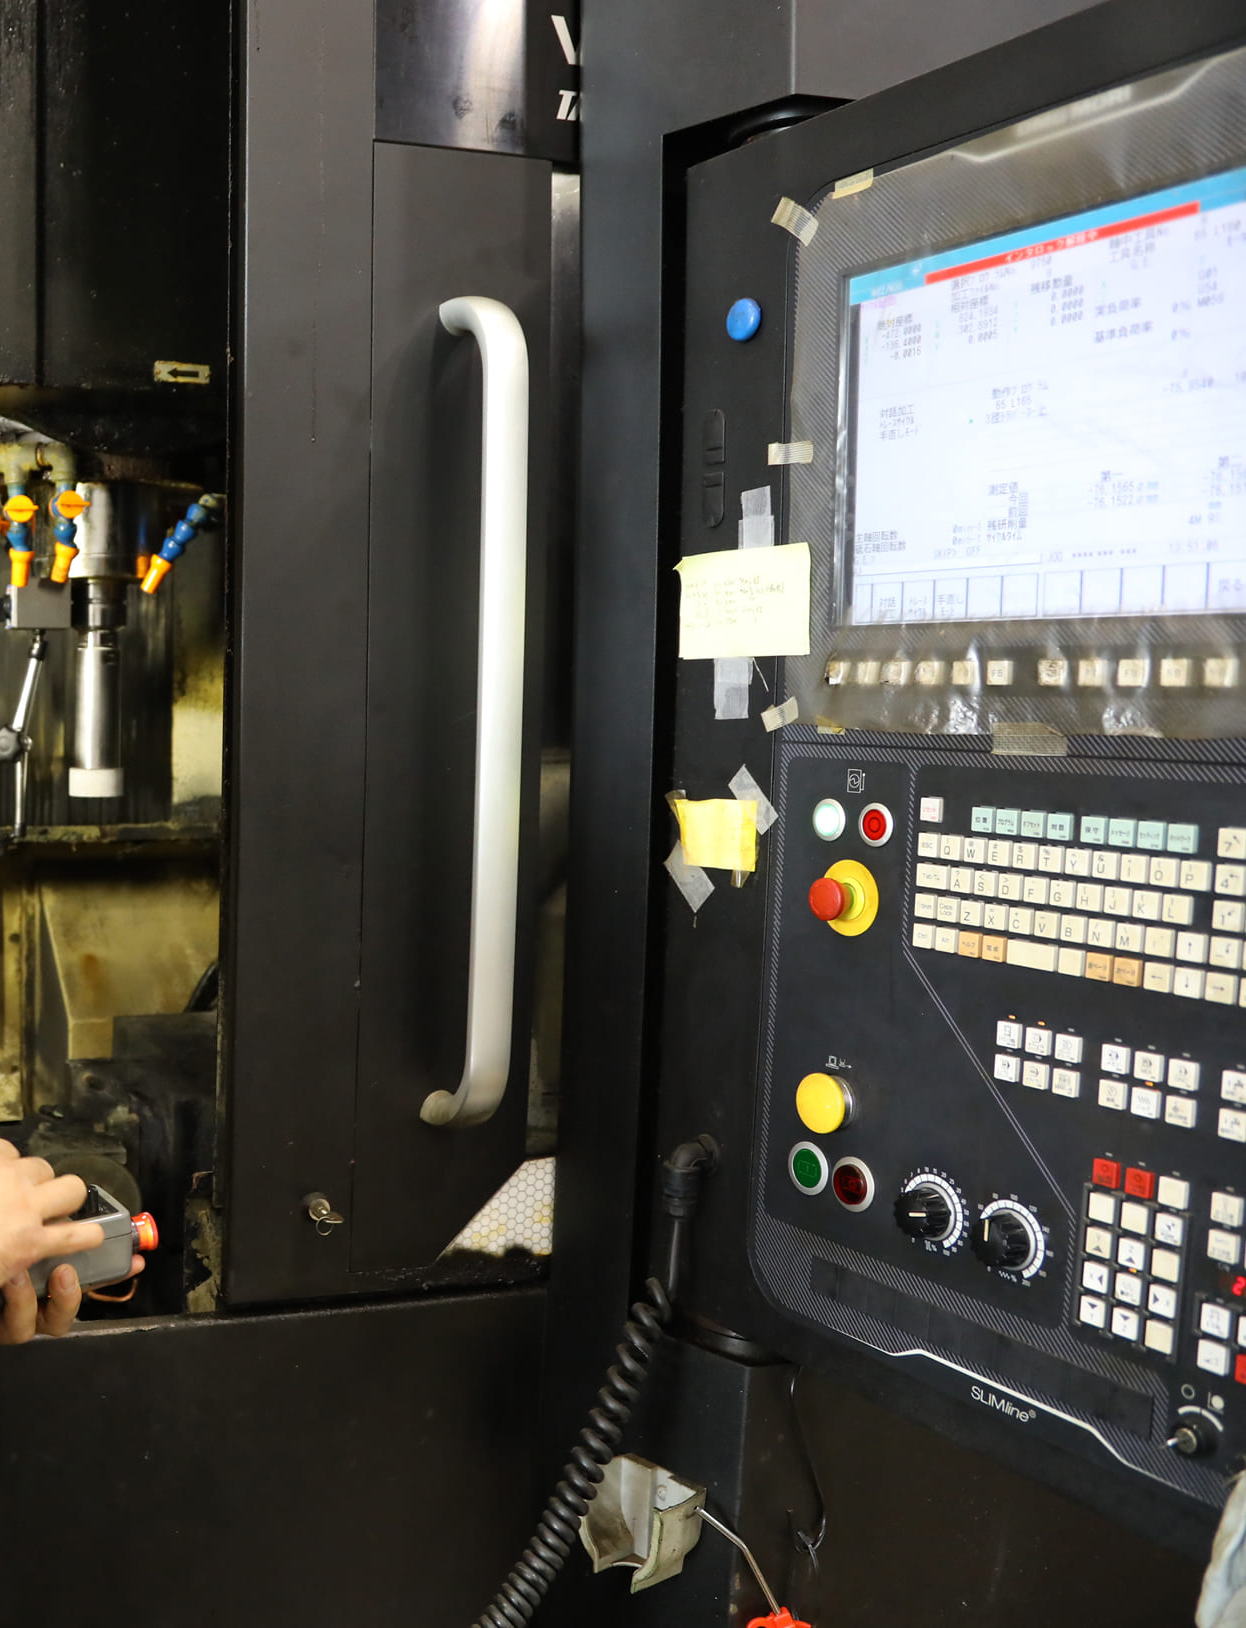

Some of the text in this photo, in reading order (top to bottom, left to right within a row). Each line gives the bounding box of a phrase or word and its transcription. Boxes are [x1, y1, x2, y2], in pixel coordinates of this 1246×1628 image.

[966, 849, 975, 858] W
[992, 851, 998, 862] E
[1016, 855, 1024, 864] R
[1043, 857, 1050, 866] T
[1070, 859, 1077, 868] Y
[1097, 863, 1105, 874] U
[953, 879, 961, 889] A
[1185, 874, 1194, 885] P
[977, 882, 985, 892] S
[1002, 885, 1010, 896] D
[1028, 888, 1034, 897] F
[1054, 892, 1062, 903] G
[1080, 895, 1089, 906] H
[1109, 900, 1116, 910] J
[1137, 904, 1145, 914] K
[1168, 908, 1175, 919] L
[964, 912, 971, 921] Z
[988, 915, 995, 925] X
[1013, 919, 1020, 930] C
[1038, 923, 1046, 933] V
[1065, 927, 1072, 938] B
[1092, 932, 1100, 942] N
[1119, 936, 1130, 947] M
